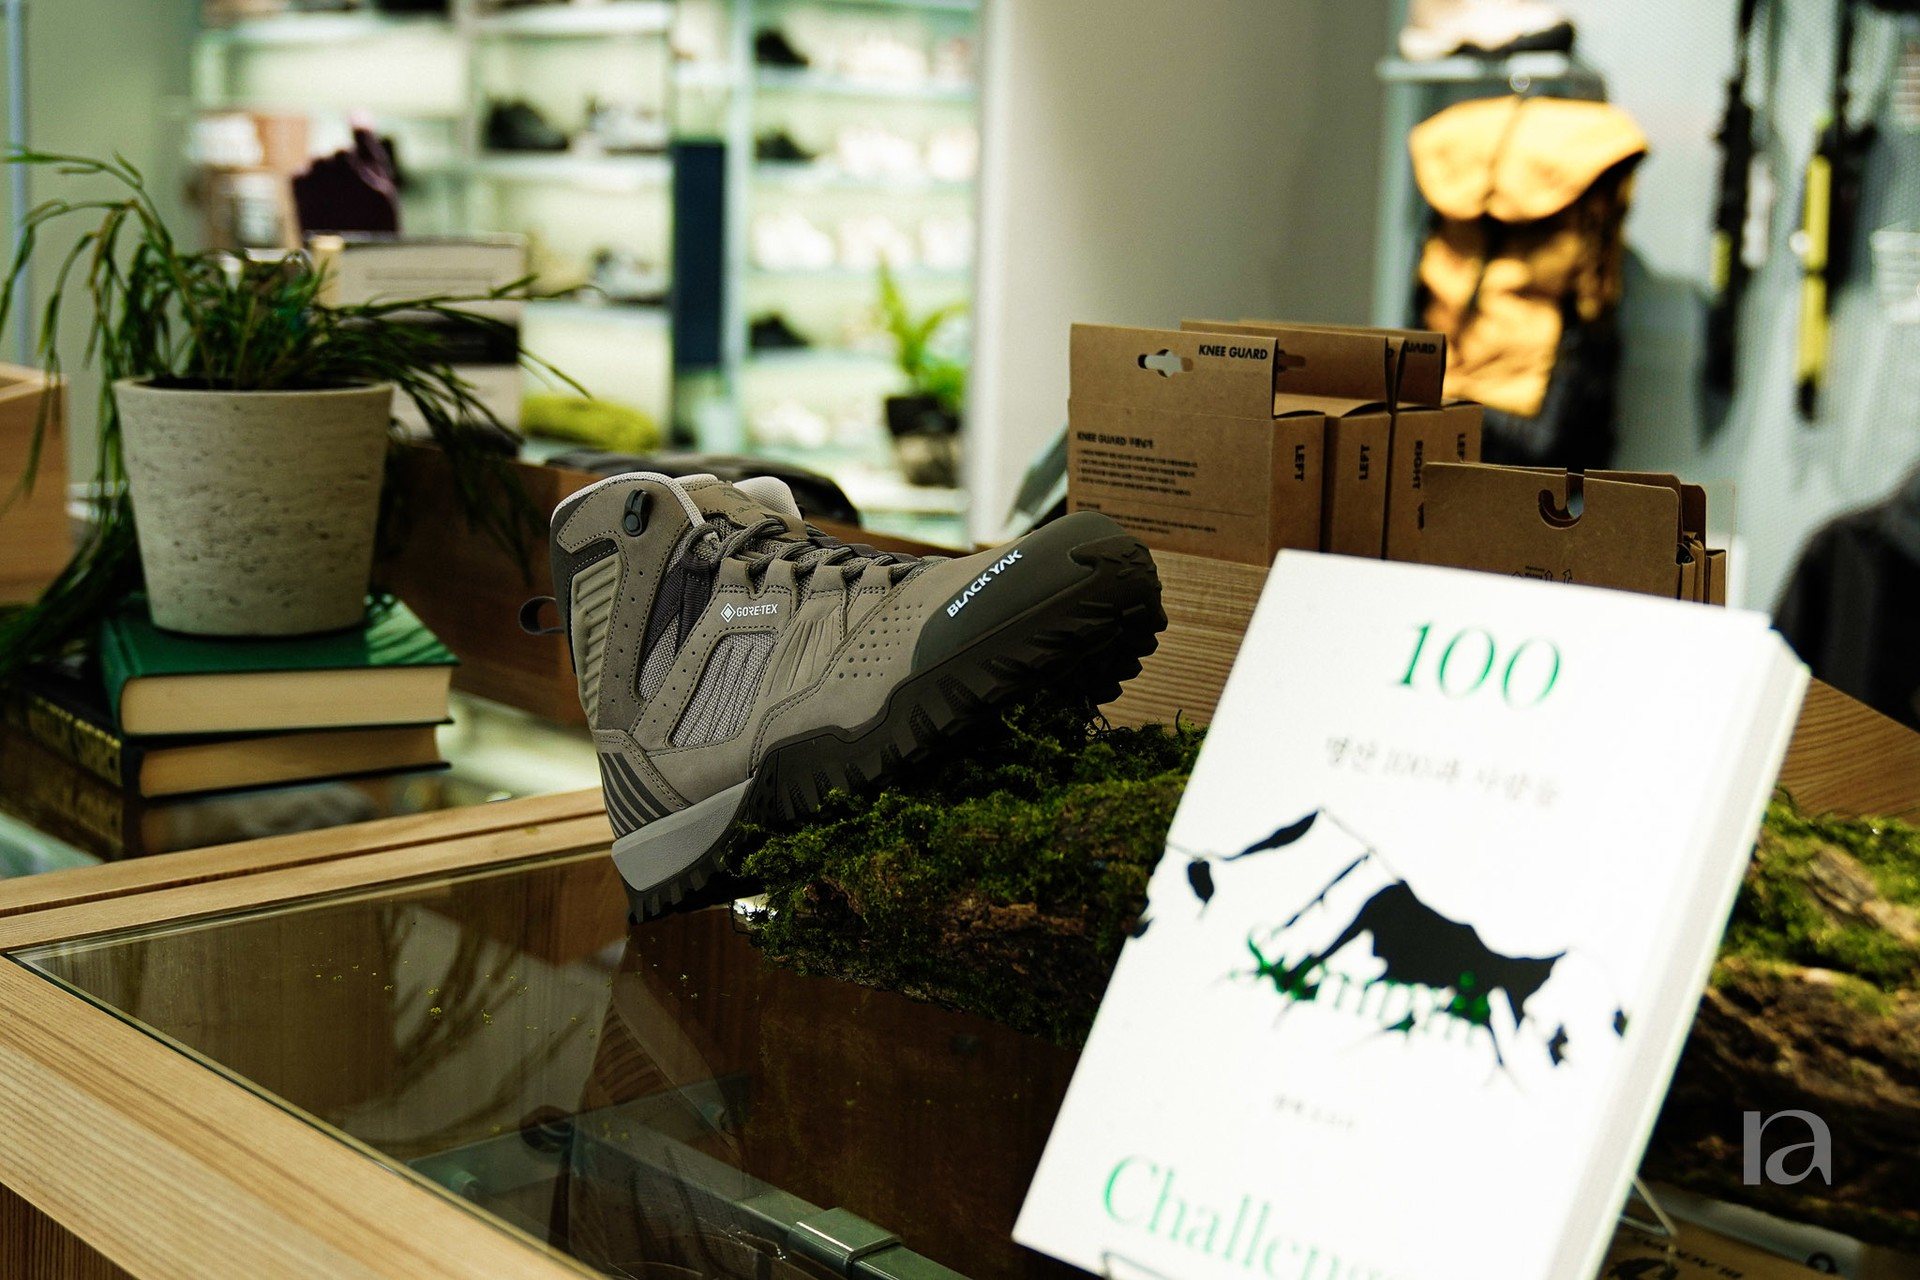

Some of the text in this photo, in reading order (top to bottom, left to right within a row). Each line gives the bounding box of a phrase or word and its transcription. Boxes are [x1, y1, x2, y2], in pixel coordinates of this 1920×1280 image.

[1198, 344, 1268, 360] KNEE GUARD
[1406, 342, 1437, 354] UARD
[1076, 431, 1098, 442] KNEE
[1098, 434, 1126, 446] GUARD
[1294, 444, 1305, 481] LEFT
[1358, 443, 1370, 480] LEFT
[1412, 440, 1424, 489] RIGHT
[946, 549, 1023, 618] BLACK YAK
[736, 603, 778, 618] GORE-TEX
[1390, 619, 1564, 710] 100
